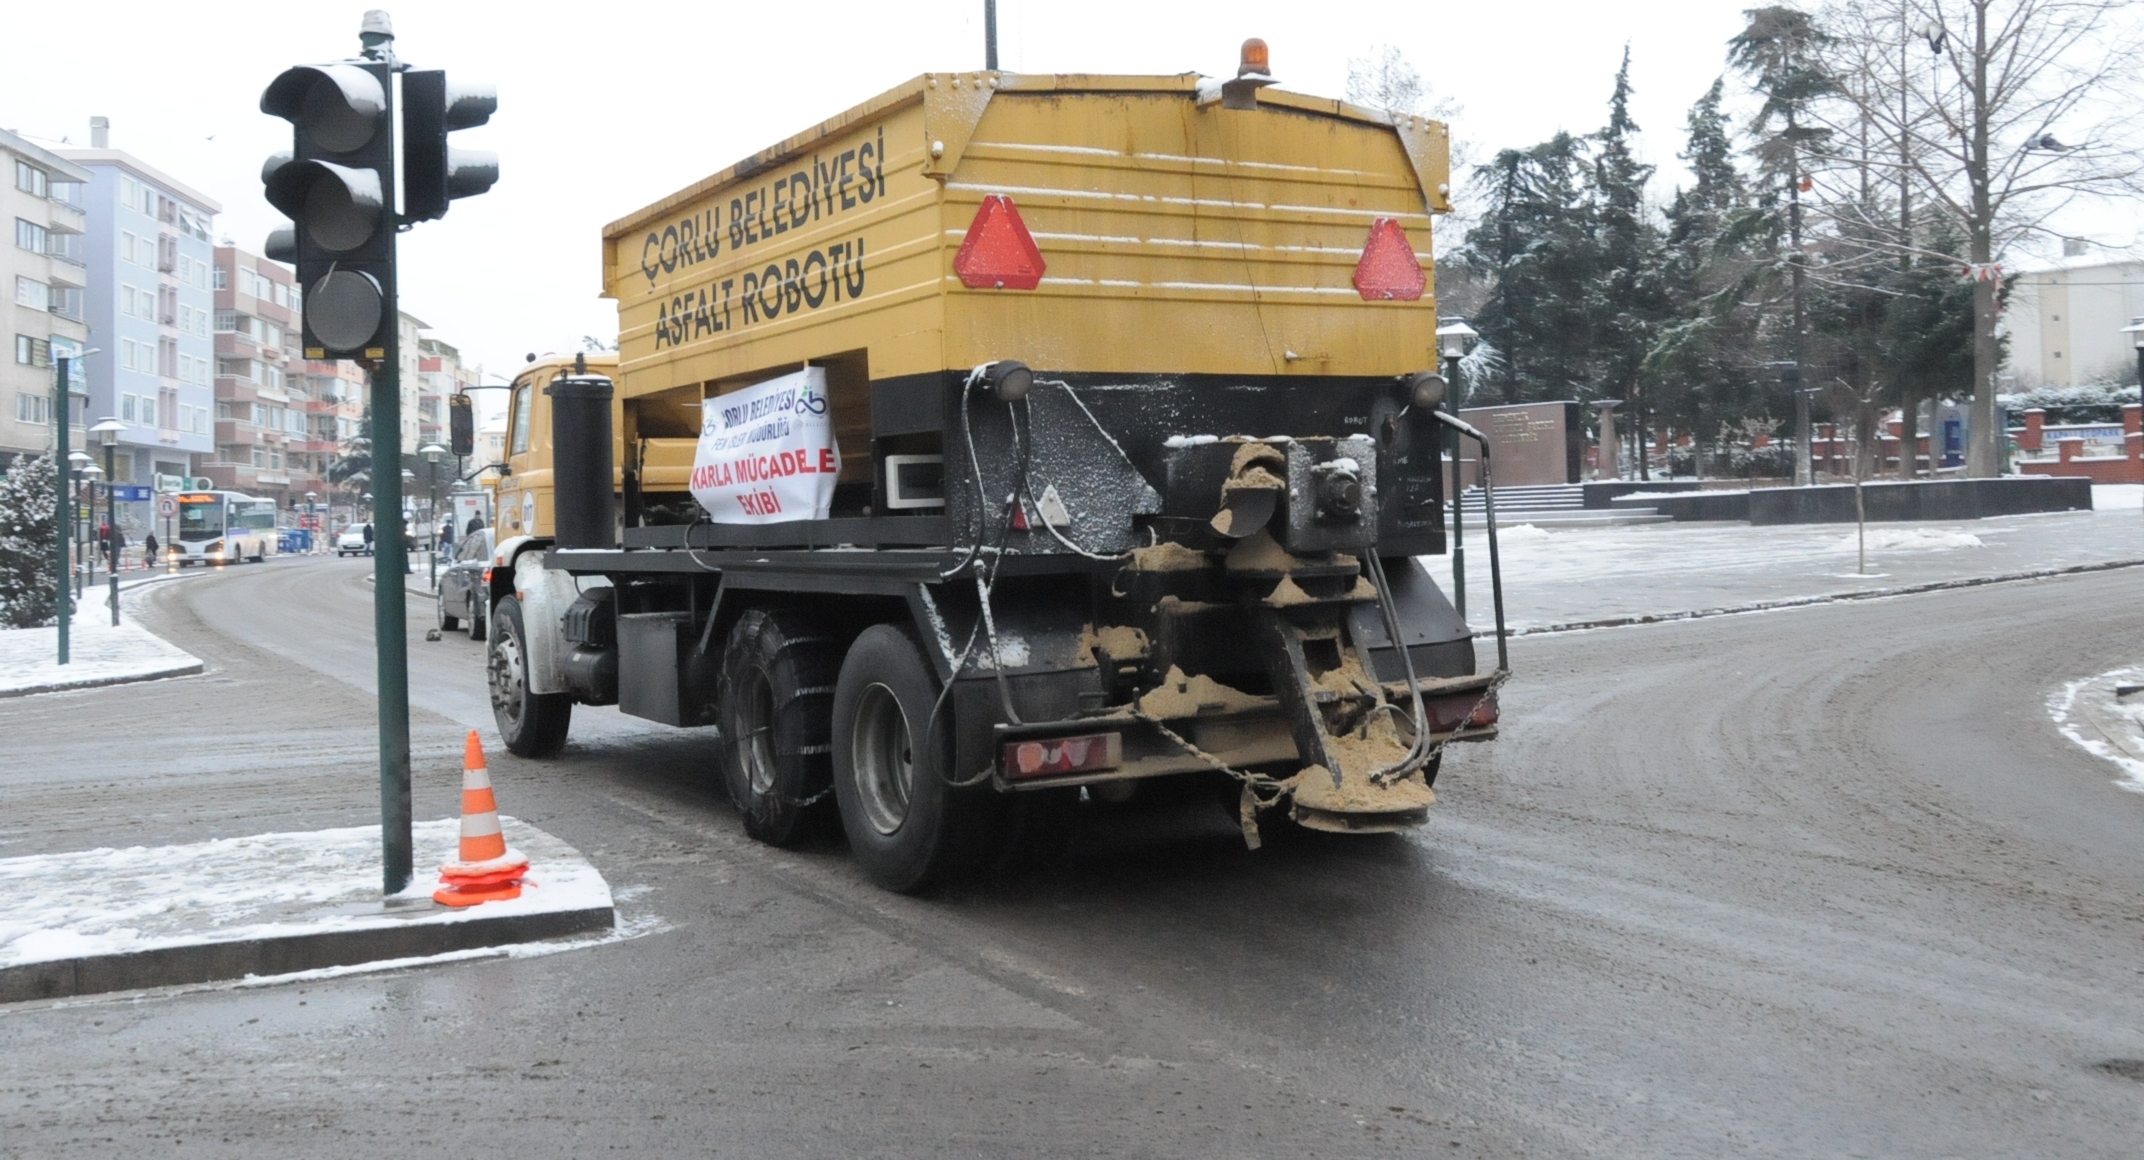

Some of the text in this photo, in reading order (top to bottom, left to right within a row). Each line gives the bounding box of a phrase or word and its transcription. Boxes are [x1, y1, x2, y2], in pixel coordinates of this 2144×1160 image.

[641, 126, 885, 294] ÇORLU BELEDİYESİ
[655, 237, 864, 350] ASFALT ROBOTU
[691, 448, 837, 490] KARLA MÜCADELE
[736, 485, 782, 516] EKİBİ
